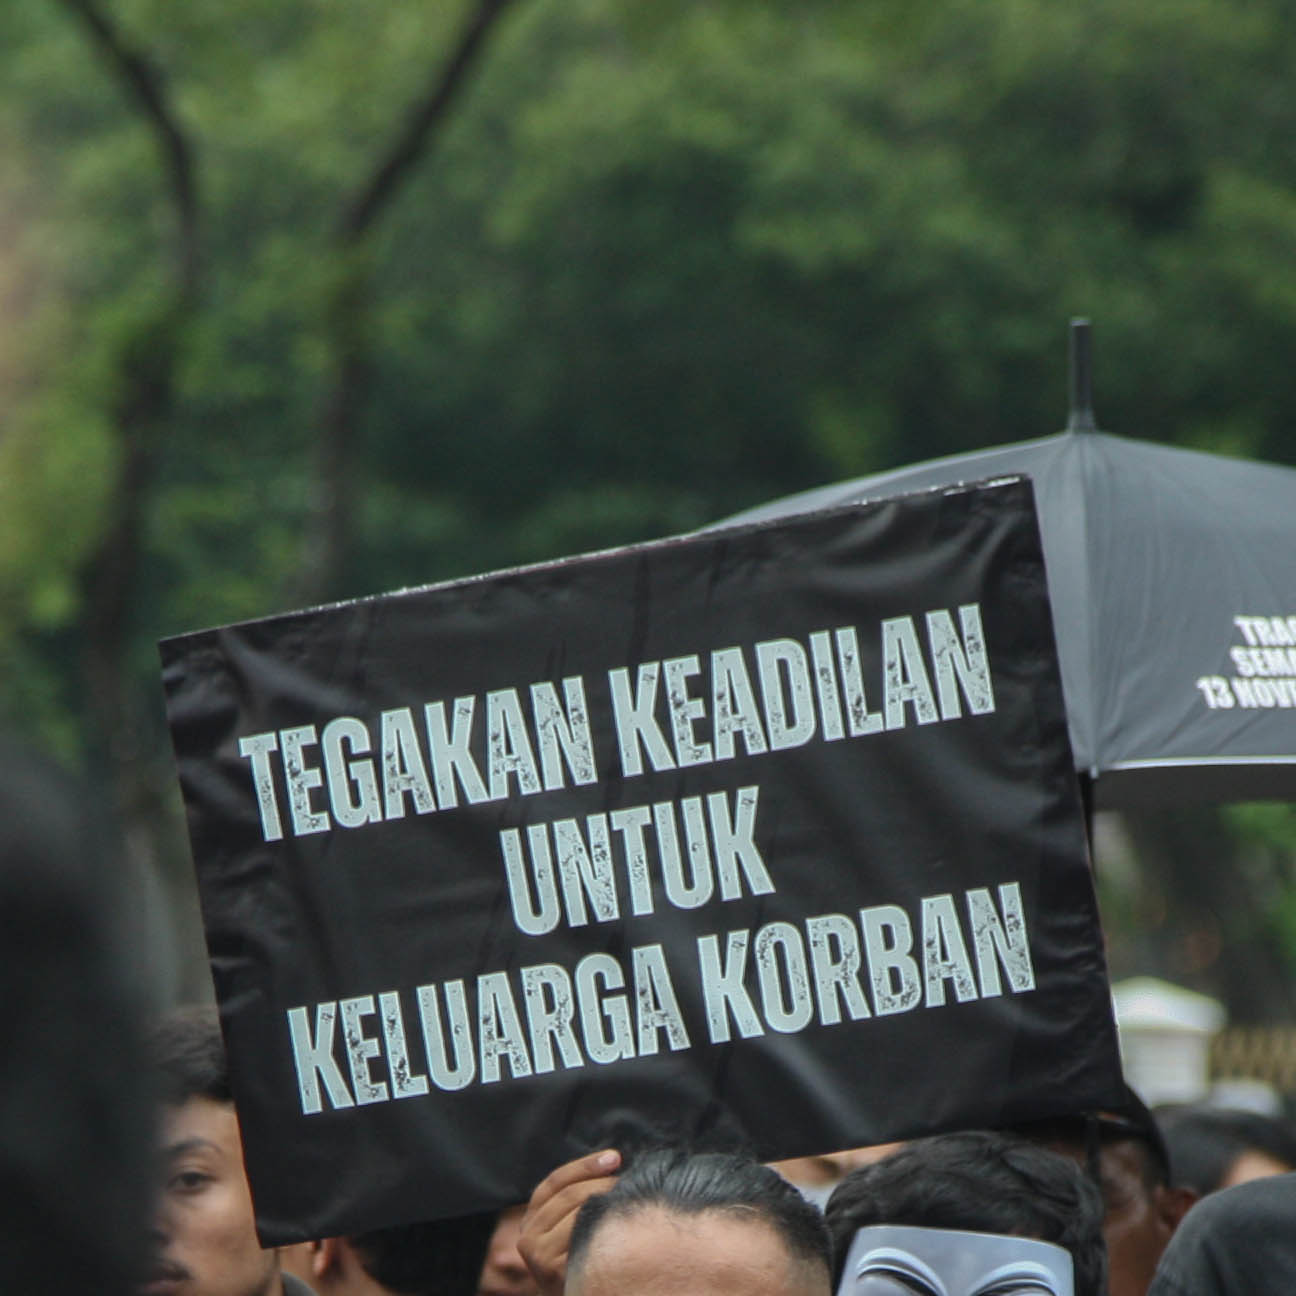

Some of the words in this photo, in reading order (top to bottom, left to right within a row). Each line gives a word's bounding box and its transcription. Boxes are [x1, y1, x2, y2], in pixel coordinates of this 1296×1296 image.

[238, 674, 597, 842] TEGAKAN
[608, 603, 995, 777] KEADILAN
[1197, 675, 1234, 709] 13
[500, 785, 775, 936] UNTUK
[287, 945, 691, 1115] KELUARGA
[698, 882, 1036, 1045] KORBAN
